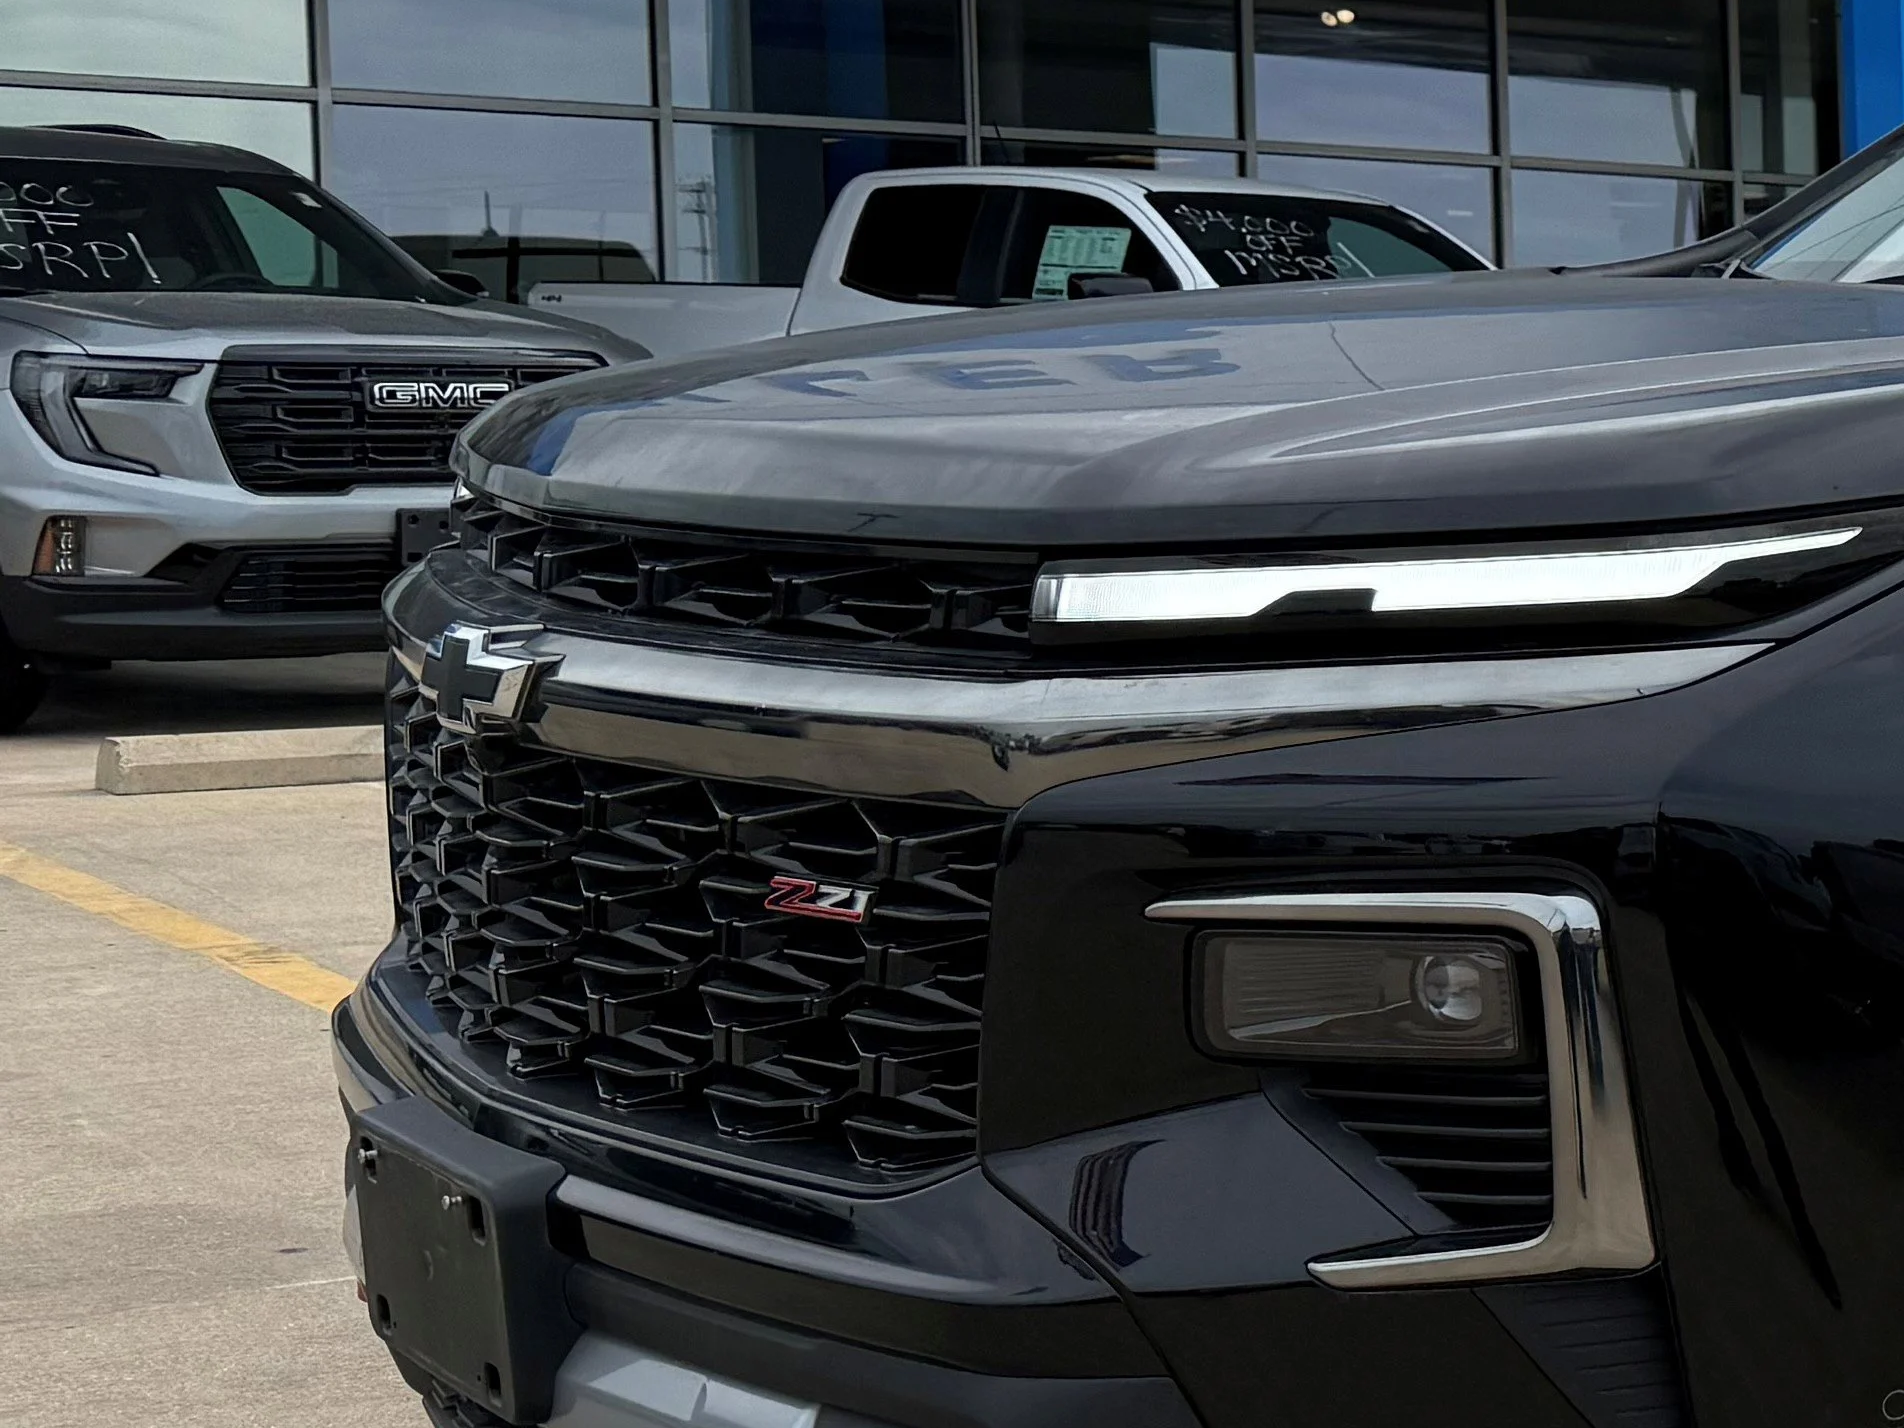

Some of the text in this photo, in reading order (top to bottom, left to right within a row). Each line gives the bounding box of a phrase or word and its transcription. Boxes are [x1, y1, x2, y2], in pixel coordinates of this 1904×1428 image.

[1246, 234, 1303, 255] OFF
[373, 382, 510, 408] GMC
[764, 875, 877, 923] Z71
